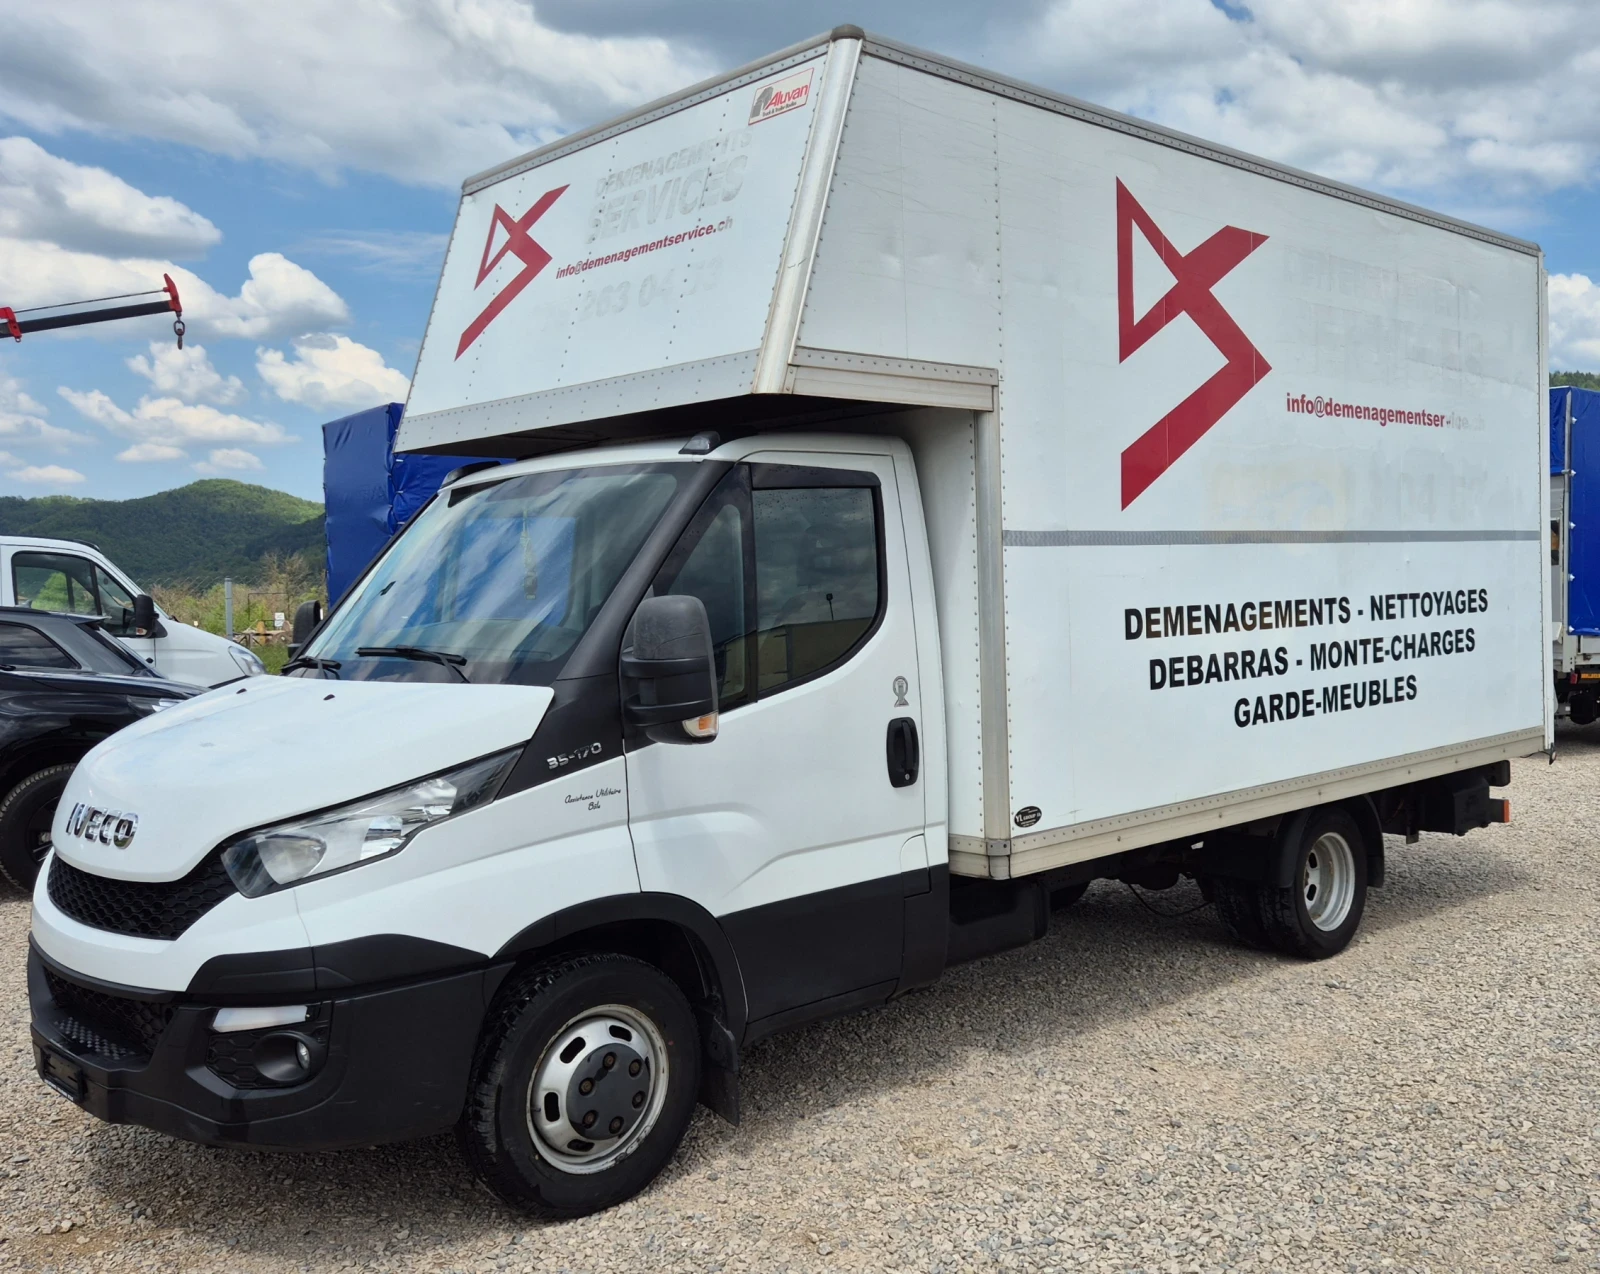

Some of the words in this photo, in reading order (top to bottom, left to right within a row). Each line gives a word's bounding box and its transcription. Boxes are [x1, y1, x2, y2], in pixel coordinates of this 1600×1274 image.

[764, 84, 809, 111] Aluvan
[586, 154, 748, 244] SERVICES
[556, 216, 733, 279] info@demenagementservice.ch
[1124, 597, 1351, 641] DEMENAGEMENTS
[1370, 588, 1489, 622] NETTOYAGES
[1149, 646, 1288, 690] DEBARRAS
[1310, 627, 1475, 672] MONTE-CHARGES
[1234, 674, 1418, 728] GARDE-MEUBLES
[547, 742, 603, 769] 35-170
[65, 802, 139, 850] IVECO
